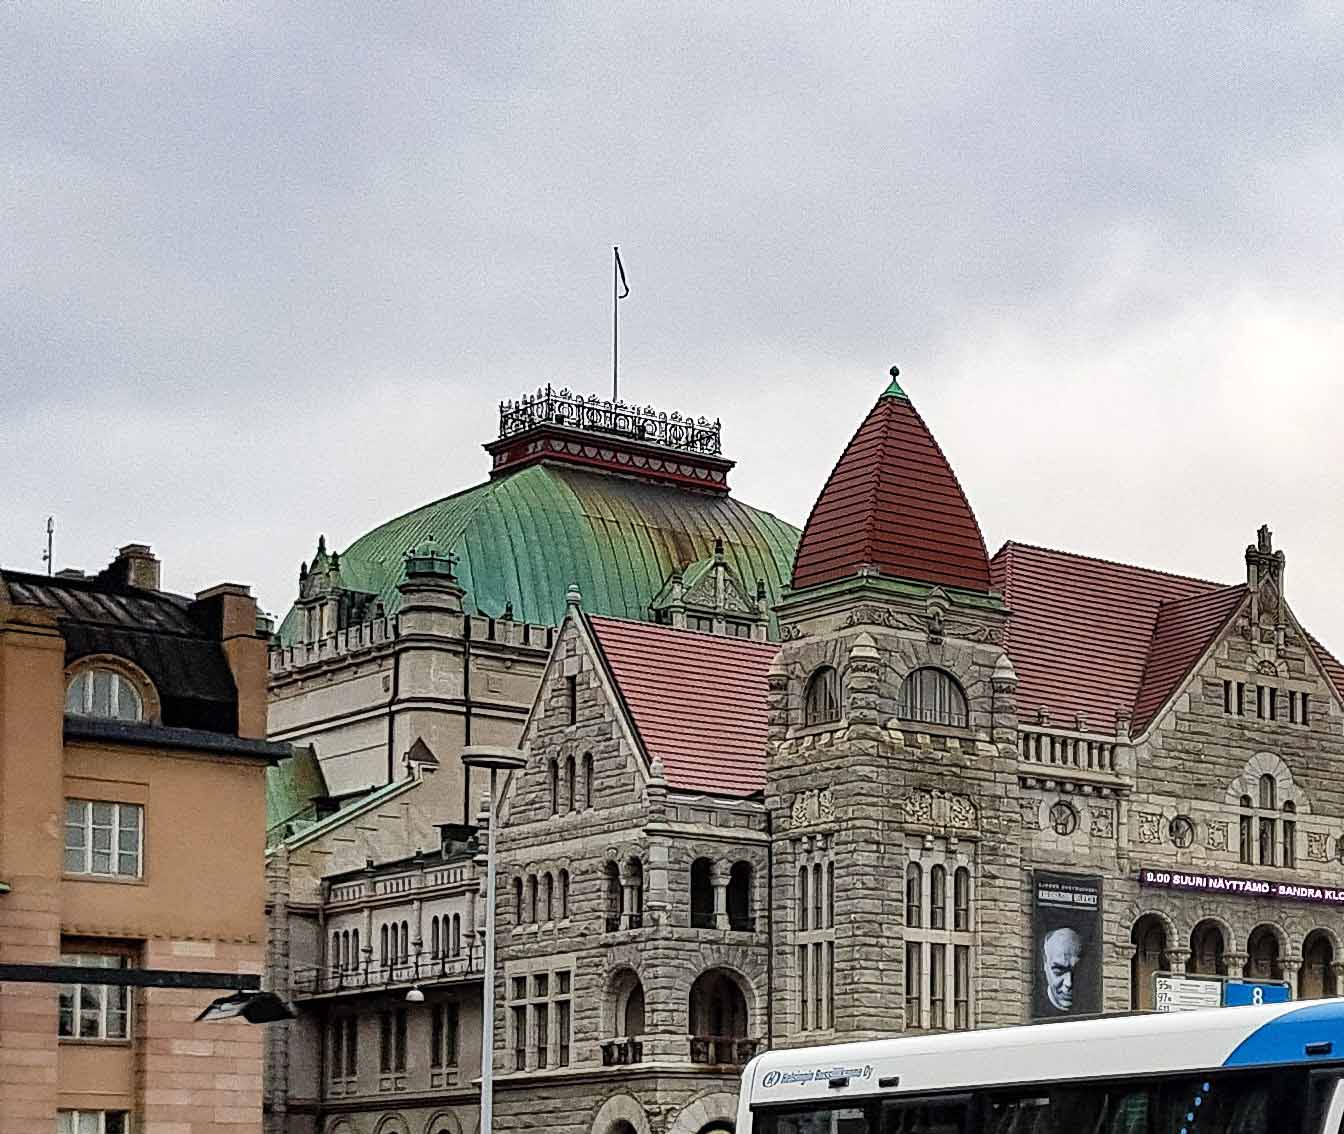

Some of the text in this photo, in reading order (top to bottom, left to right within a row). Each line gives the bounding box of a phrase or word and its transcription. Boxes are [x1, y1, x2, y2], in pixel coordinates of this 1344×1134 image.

[1173, 874, 1206, 888] SUURI
[1279, 885, 1322, 900] SANDRA
[1252, 987, 1263, 1006] 8
